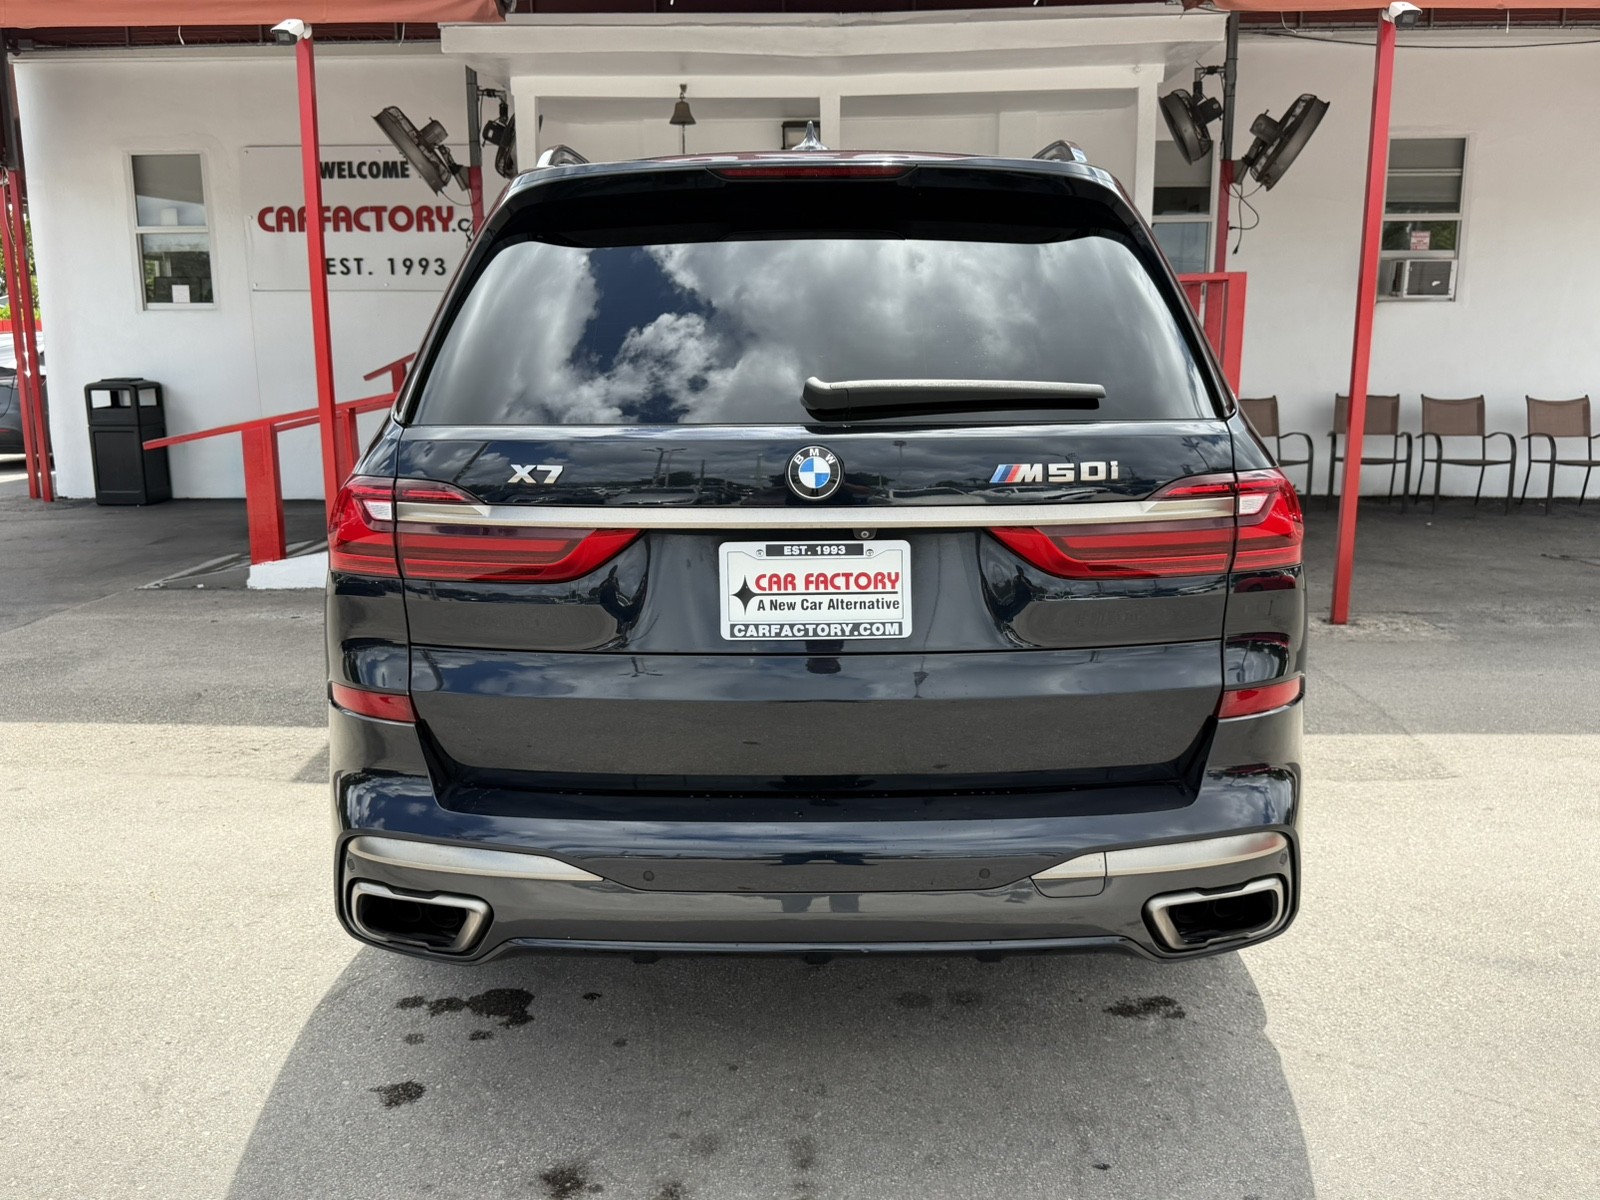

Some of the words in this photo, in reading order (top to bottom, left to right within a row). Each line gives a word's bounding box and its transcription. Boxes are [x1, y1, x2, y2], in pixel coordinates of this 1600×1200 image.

[319, 161, 410, 179] WELCOME
[325, 257, 373, 275] EST.
[387, 257, 447, 276] 1993
[794, 448, 836, 465] BMW
[507, 464, 565, 484] X7
[783, 545, 812, 556] EST.
[816, 545, 846, 555] 1993
[755, 573, 797, 592] CAR
[804, 571, 900, 591] FACTORY
[757, 599, 766, 611] A
[769, 599, 797, 611] New
[800, 598, 824, 611] Car
[827, 597, 900, 611] Alternative
[733, 623, 900, 638] CARFACTORY.COM
